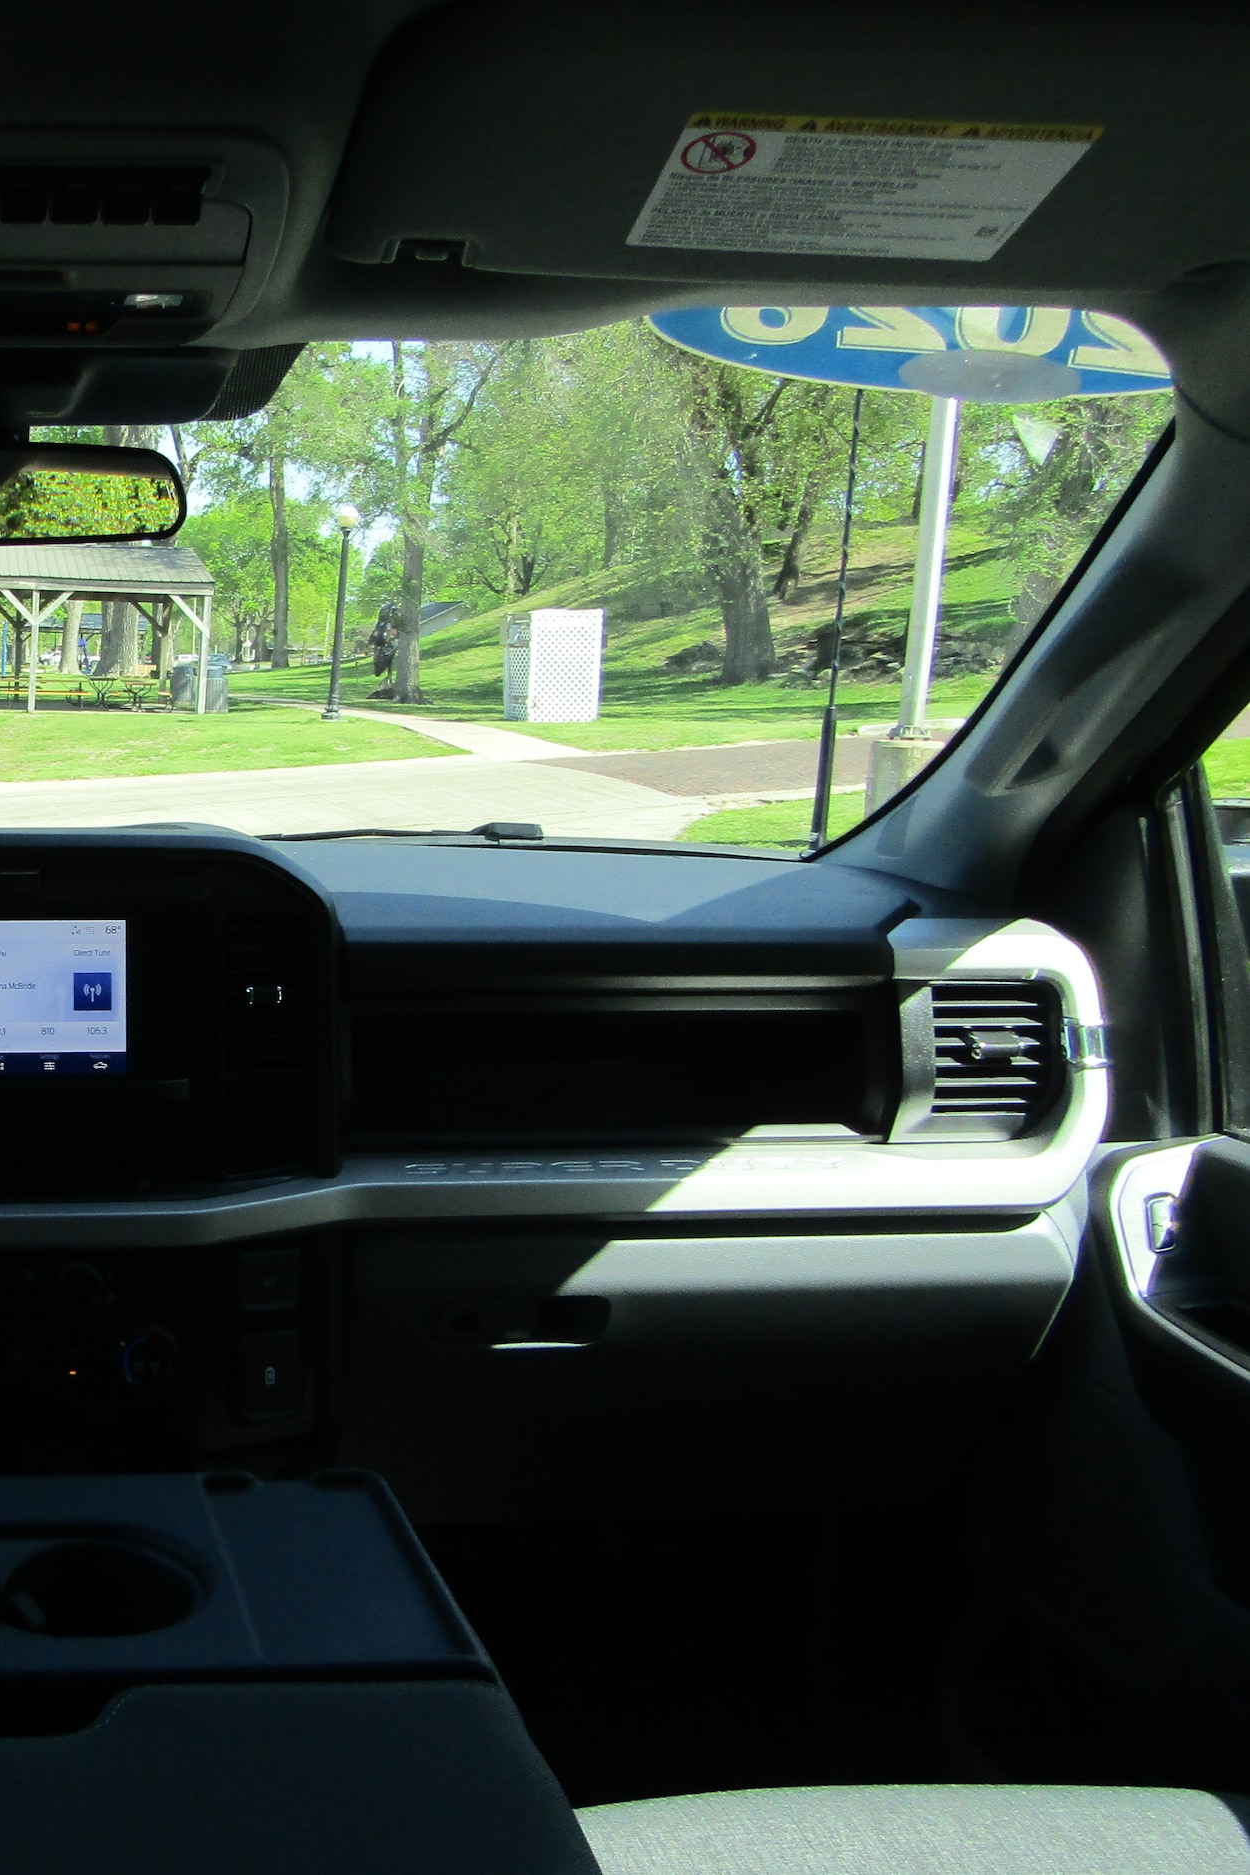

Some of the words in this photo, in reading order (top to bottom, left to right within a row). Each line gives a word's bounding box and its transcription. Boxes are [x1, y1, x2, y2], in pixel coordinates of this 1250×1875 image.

[105, 925, 121, 935] 68°
[74, 949, 92, 957] Direct
[94, 949, 111, 957] Tune
[8, 982, 36, 990] McBride
[41, 1027, 55, 1036] 810
[87, 1027, 107, 1036] 106.3
[405, 1159, 645, 1177] SUPER
